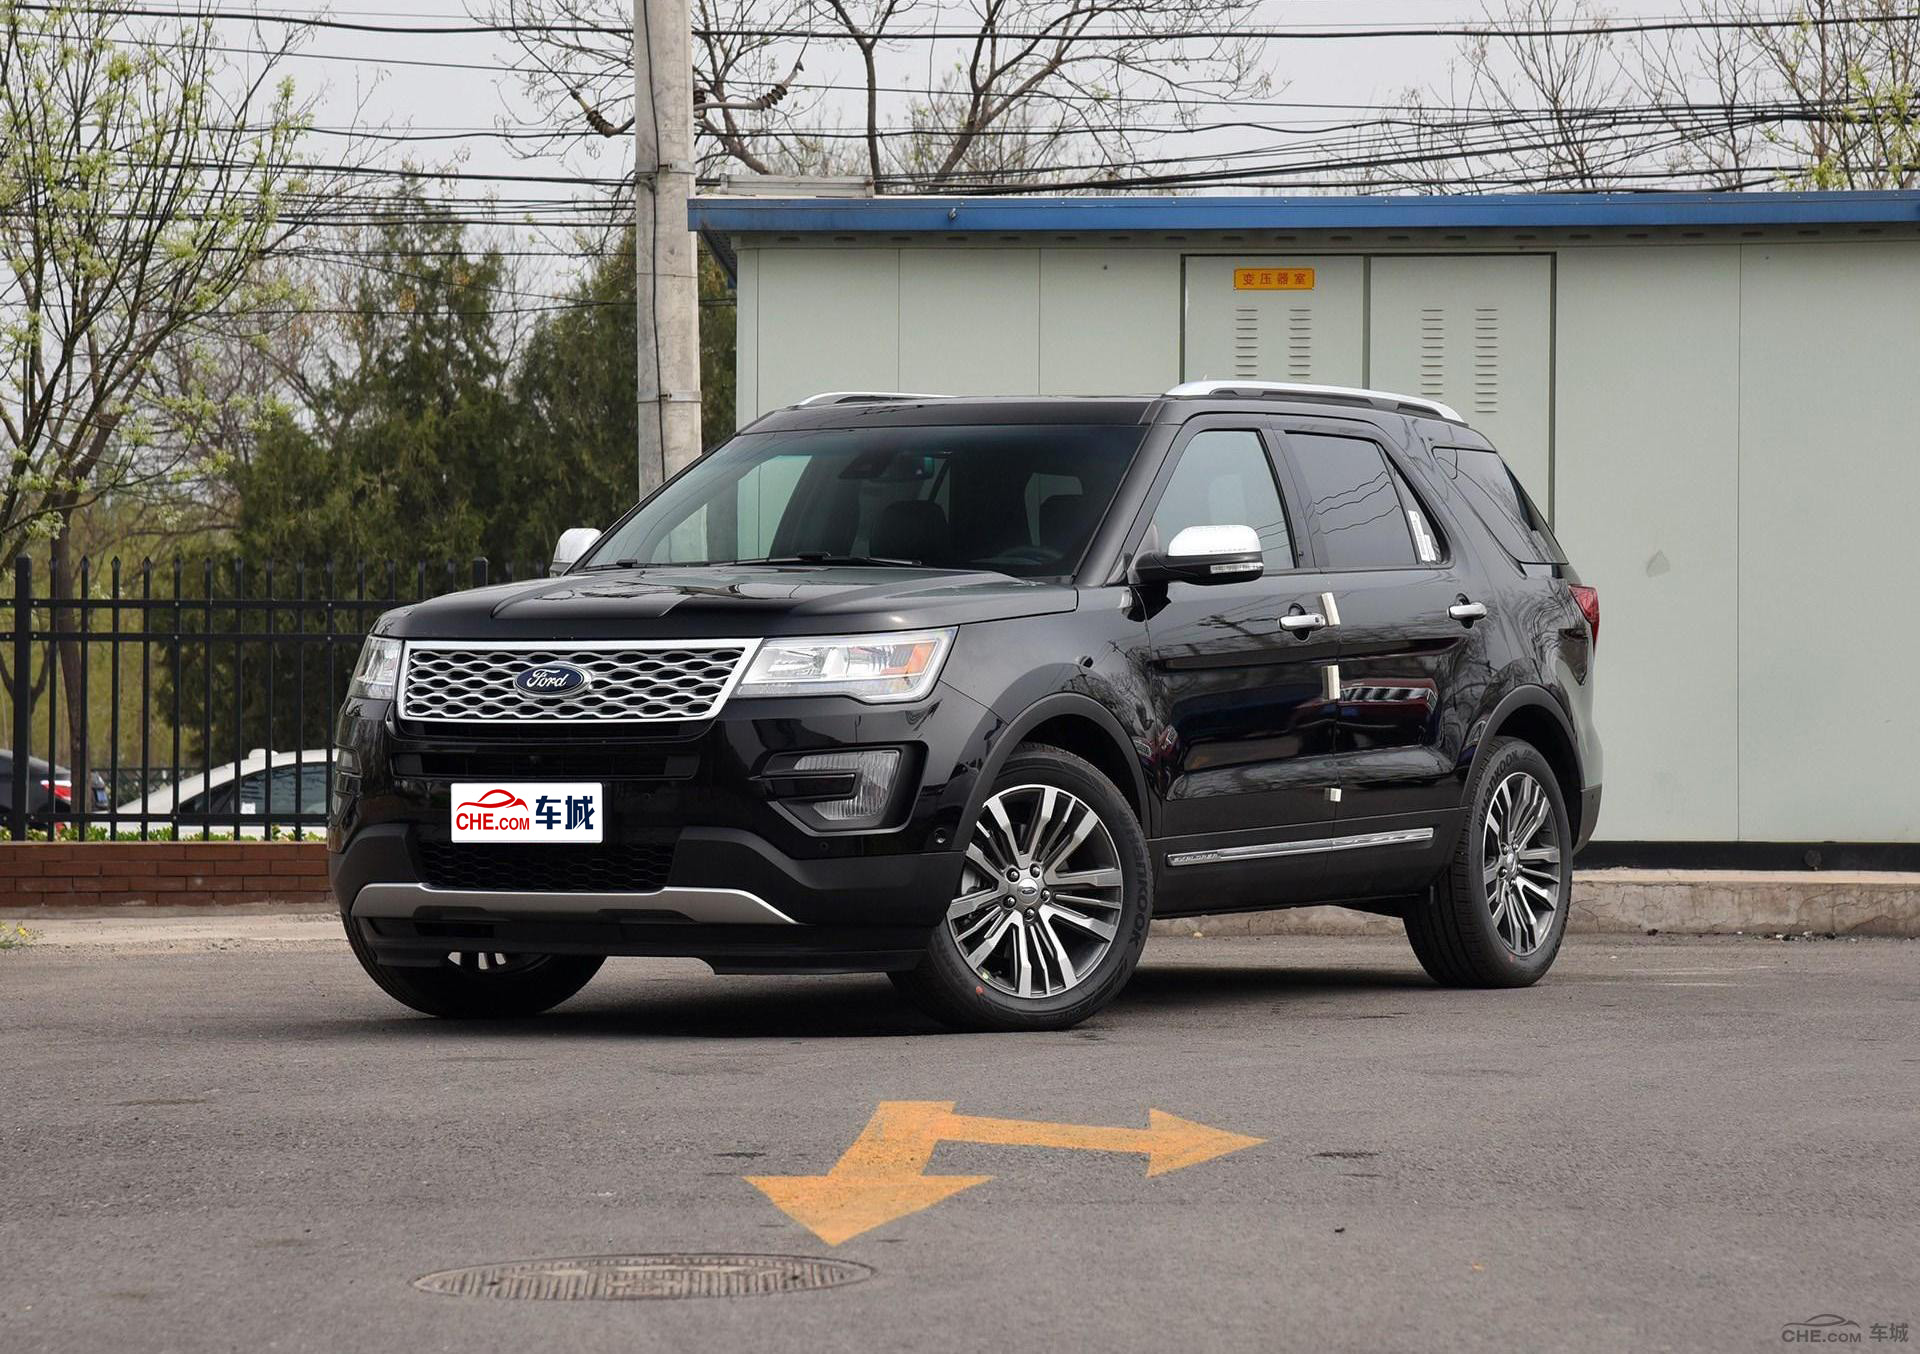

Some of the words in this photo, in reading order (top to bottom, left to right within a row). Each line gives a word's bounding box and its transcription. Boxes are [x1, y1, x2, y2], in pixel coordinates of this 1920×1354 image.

[1243, 272, 1305, 286] 变压器室
[526, 668, 569, 687] Ford
